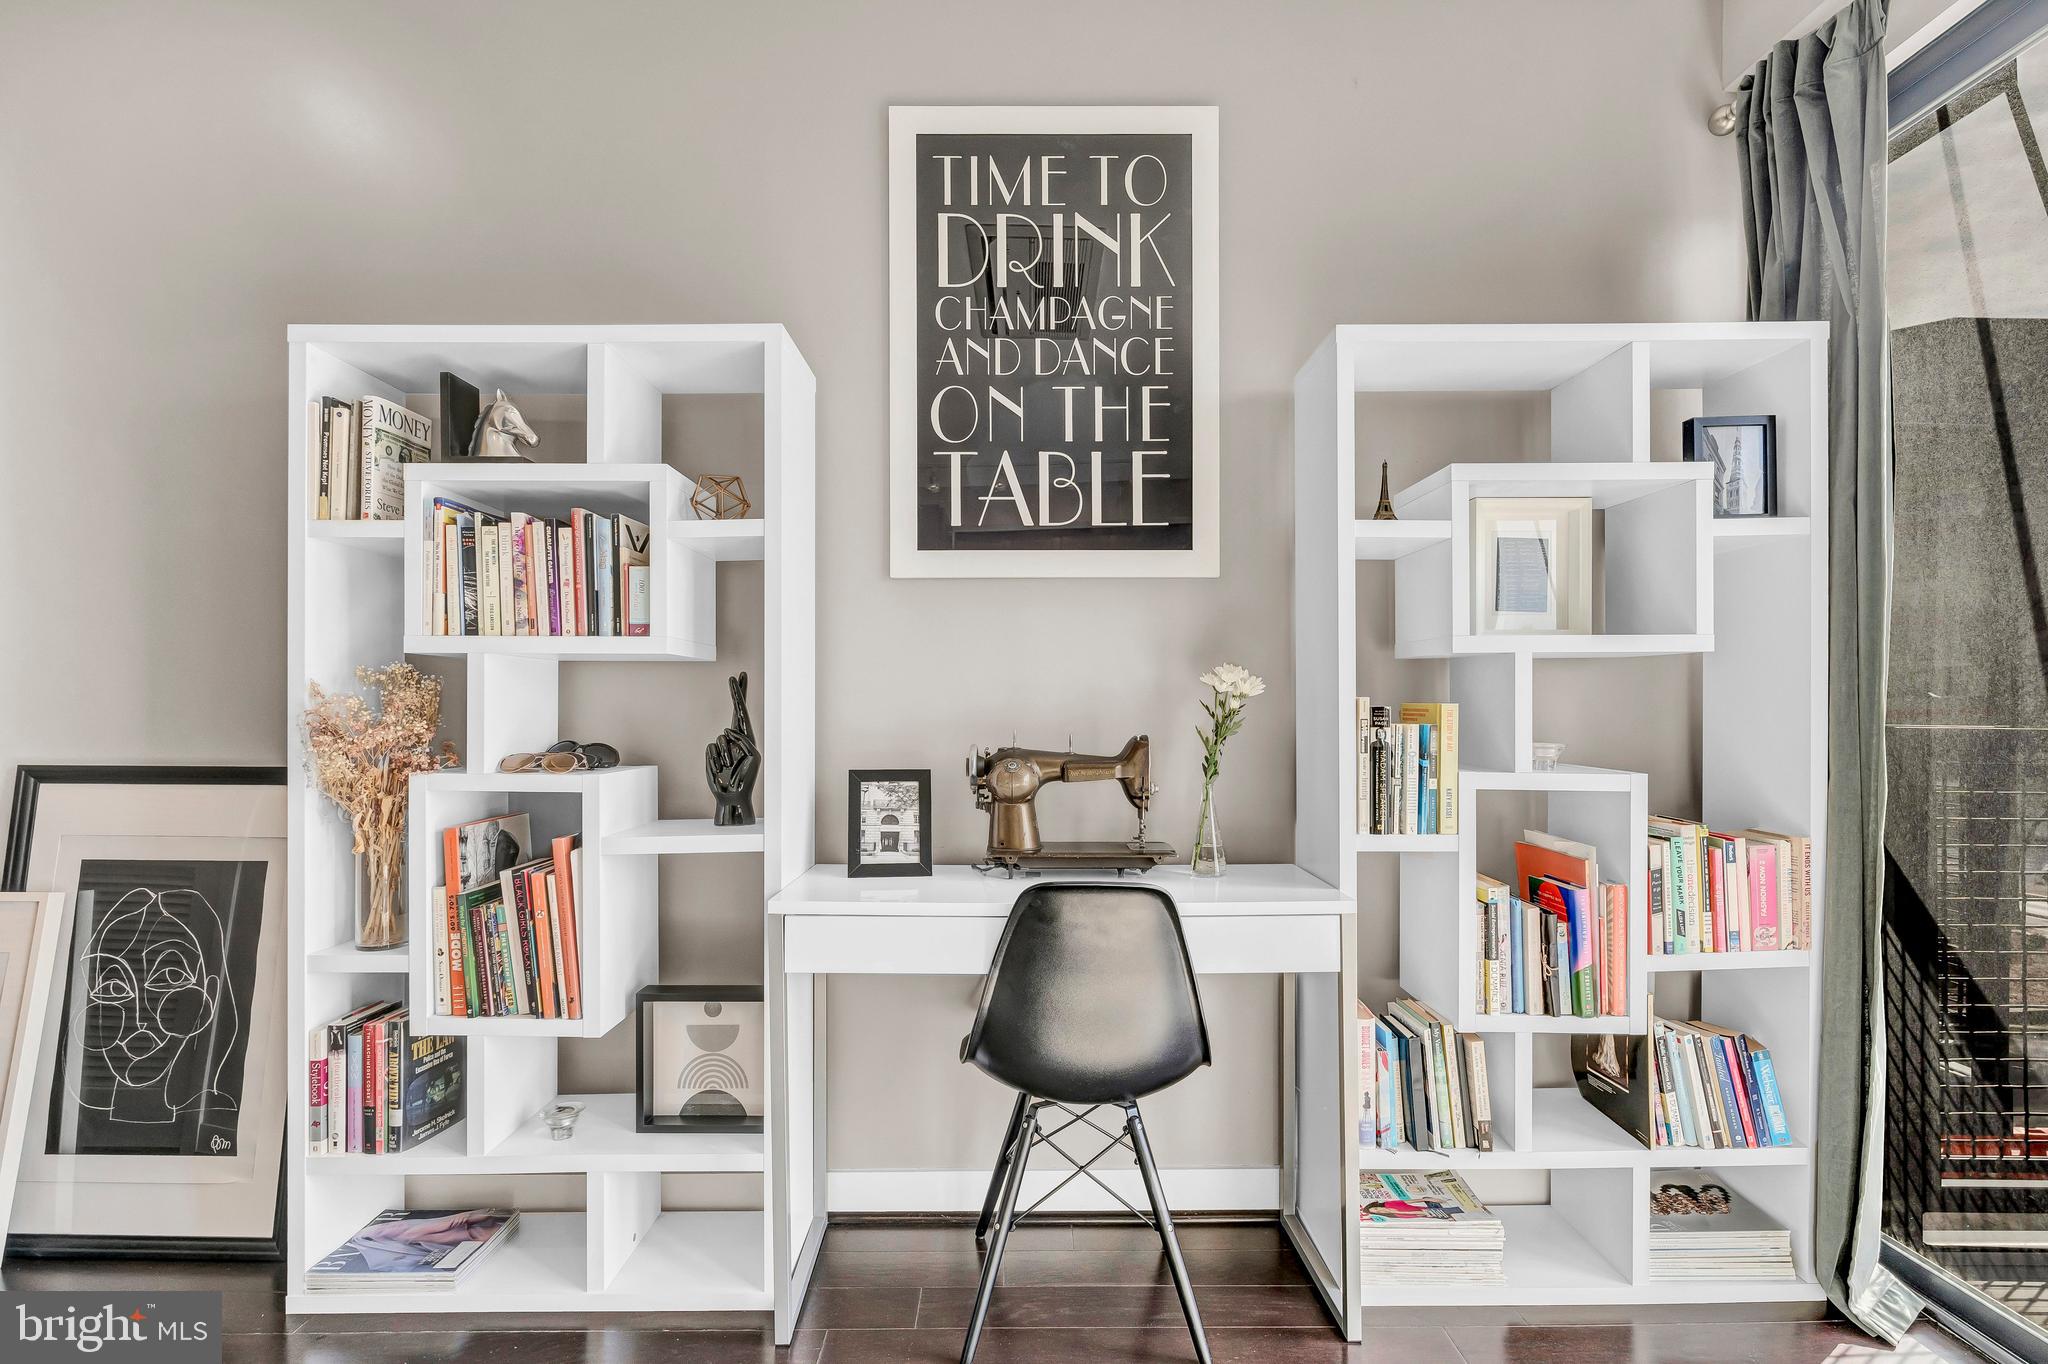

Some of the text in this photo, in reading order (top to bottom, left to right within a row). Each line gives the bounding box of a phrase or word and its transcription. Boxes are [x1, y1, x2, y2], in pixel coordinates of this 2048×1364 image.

[932, 154, 1167, 206] TIME TO
[937, 212, 1175, 288] DRINK
[935, 295, 1173, 331] CHAMPAGNE
[936, 337, 1174, 376] AND DANCE
[363, 400, 373, 440] MONEY
[378, 404, 431, 441] MONEY
[930, 385, 1170, 443] ON THE
[321, 472, 329, 485] Kept
[932, 449, 1170, 527] TABLE
[376, 498, 401, 515] Steve
[1674, 841, 1684, 905] LEAVE YOUR MARK
[1760, 887, 1768, 917] FASHION
[1805, 888, 1810, 896] US
[514, 878, 531, 969] BLACK GIRLS ROCK!
[451, 933, 461, 971] MODE
[453, 984, 464, 1008] ELLE
[411, 1038, 435, 1060] THE
[1432, 1028, 1439, 1037] My
[310, 1062, 320, 1105] Stylebook
[389, 1051, 399, 1081] ABOVE
[1662, 1057, 1670, 1081] Relations
[1760, 1064, 1776, 1104] Webster
[389, 1084, 399, 1102] THE
